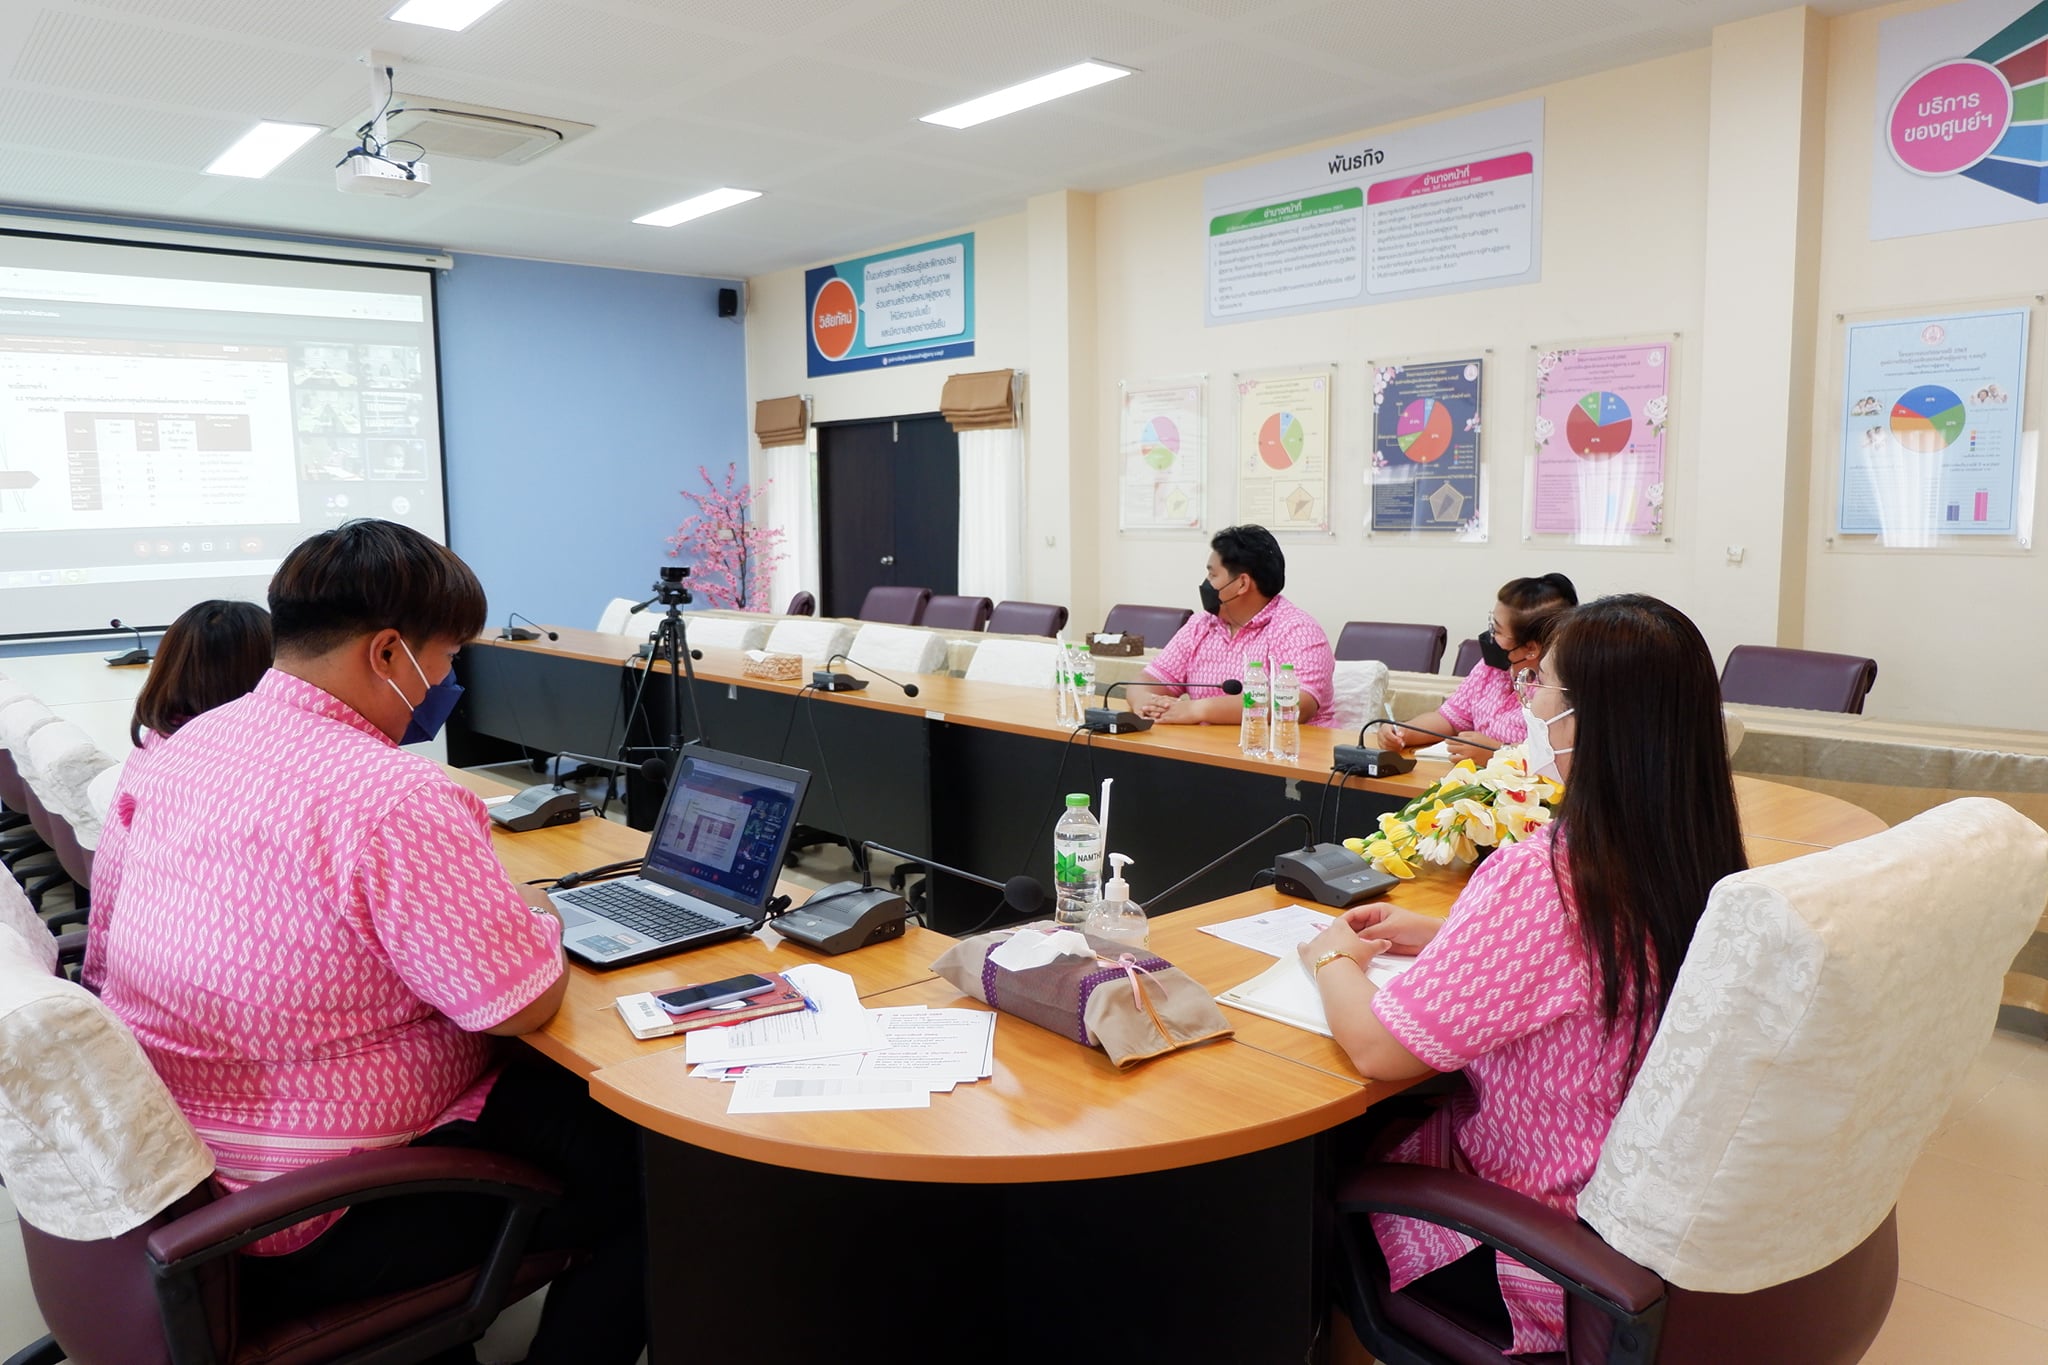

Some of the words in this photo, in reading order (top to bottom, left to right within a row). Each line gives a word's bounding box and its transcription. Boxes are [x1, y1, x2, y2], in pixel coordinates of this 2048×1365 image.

[1918, 92, 1980, 117] บริการ
[1904, 111, 1993, 142] ของศูนย์ฯ
[1328, 148, 1384, 175] พันธกิจ
[1423, 165, 1470, 186] อำนาจหน้าที่
[1264, 200, 1303, 218] อำนาจหน้าที่
[819, 309, 852, 328] วิสัยทัศน์
